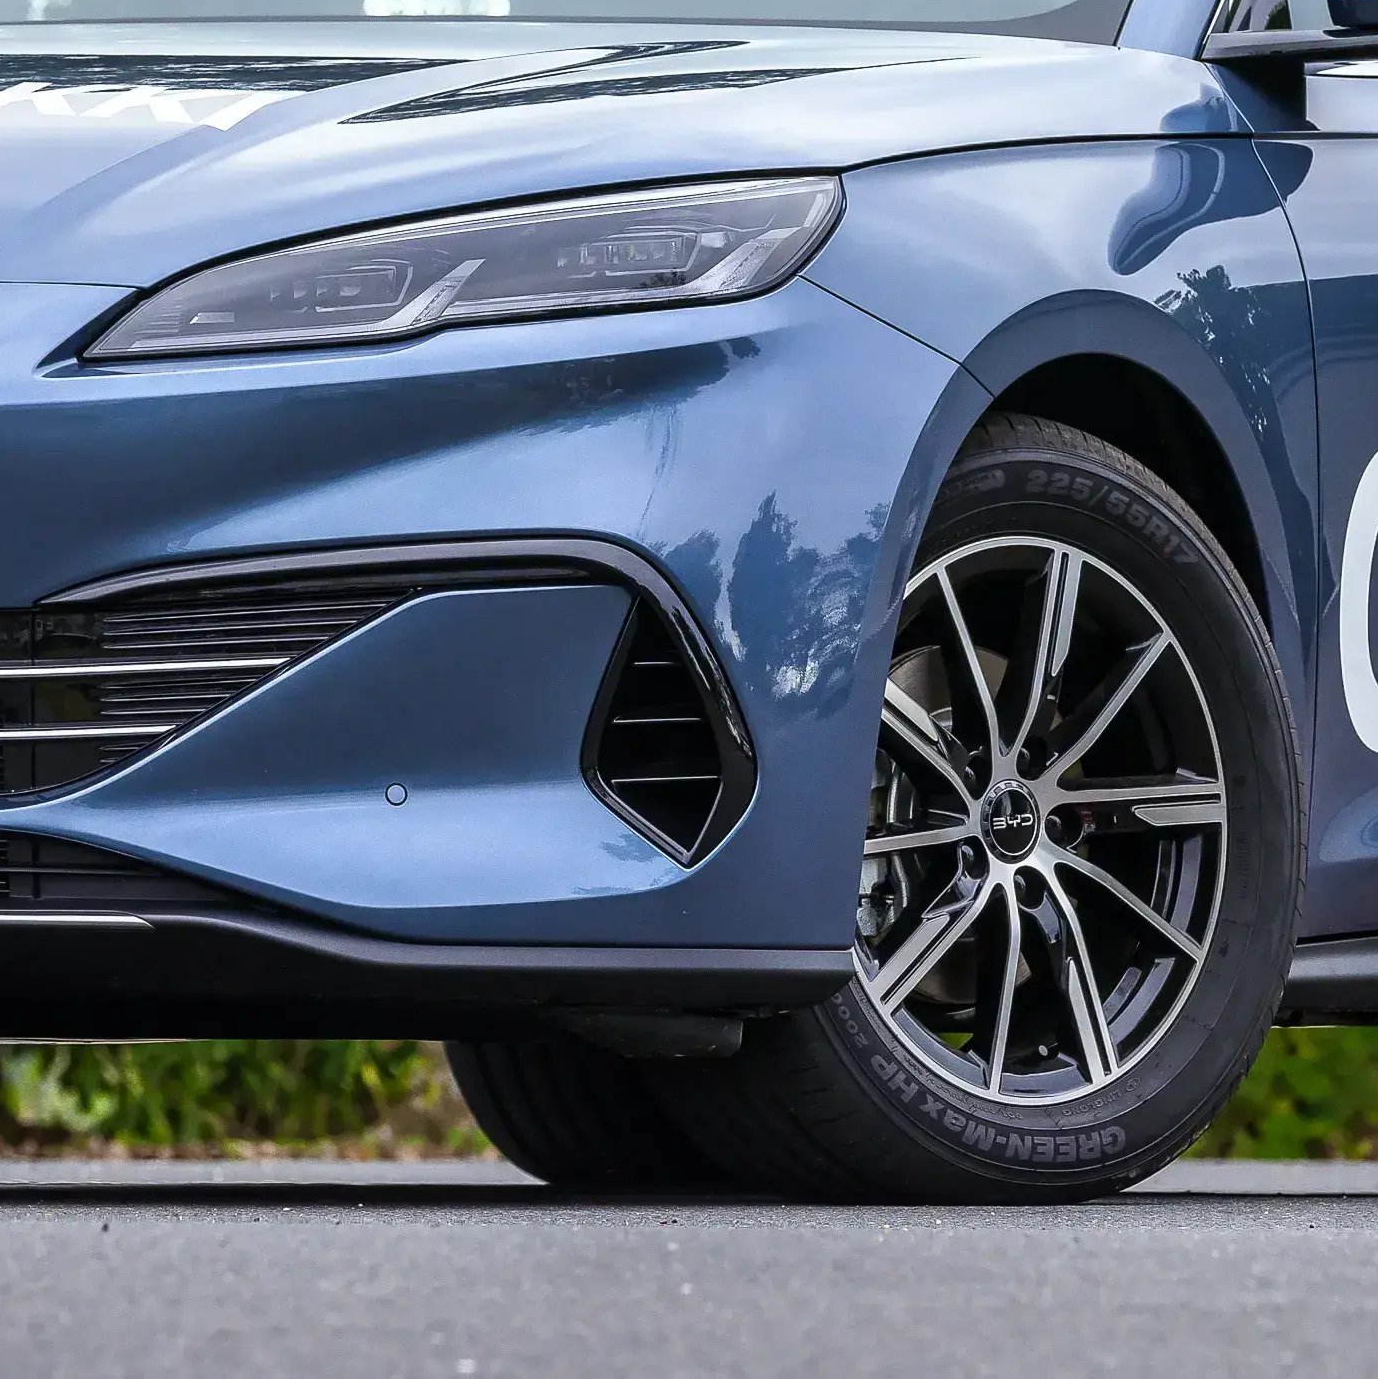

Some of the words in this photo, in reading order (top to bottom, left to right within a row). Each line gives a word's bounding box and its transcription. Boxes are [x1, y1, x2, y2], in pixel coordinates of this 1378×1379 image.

[1024, 468, 1200, 565] 225/55R17
[992, 813, 1034, 830] BYD
[870, 1054, 919, 1103] HP
[1060, 1087, 1122, 1117] LINGLONG
[920, 1094, 1127, 1163] GREEN-Max
